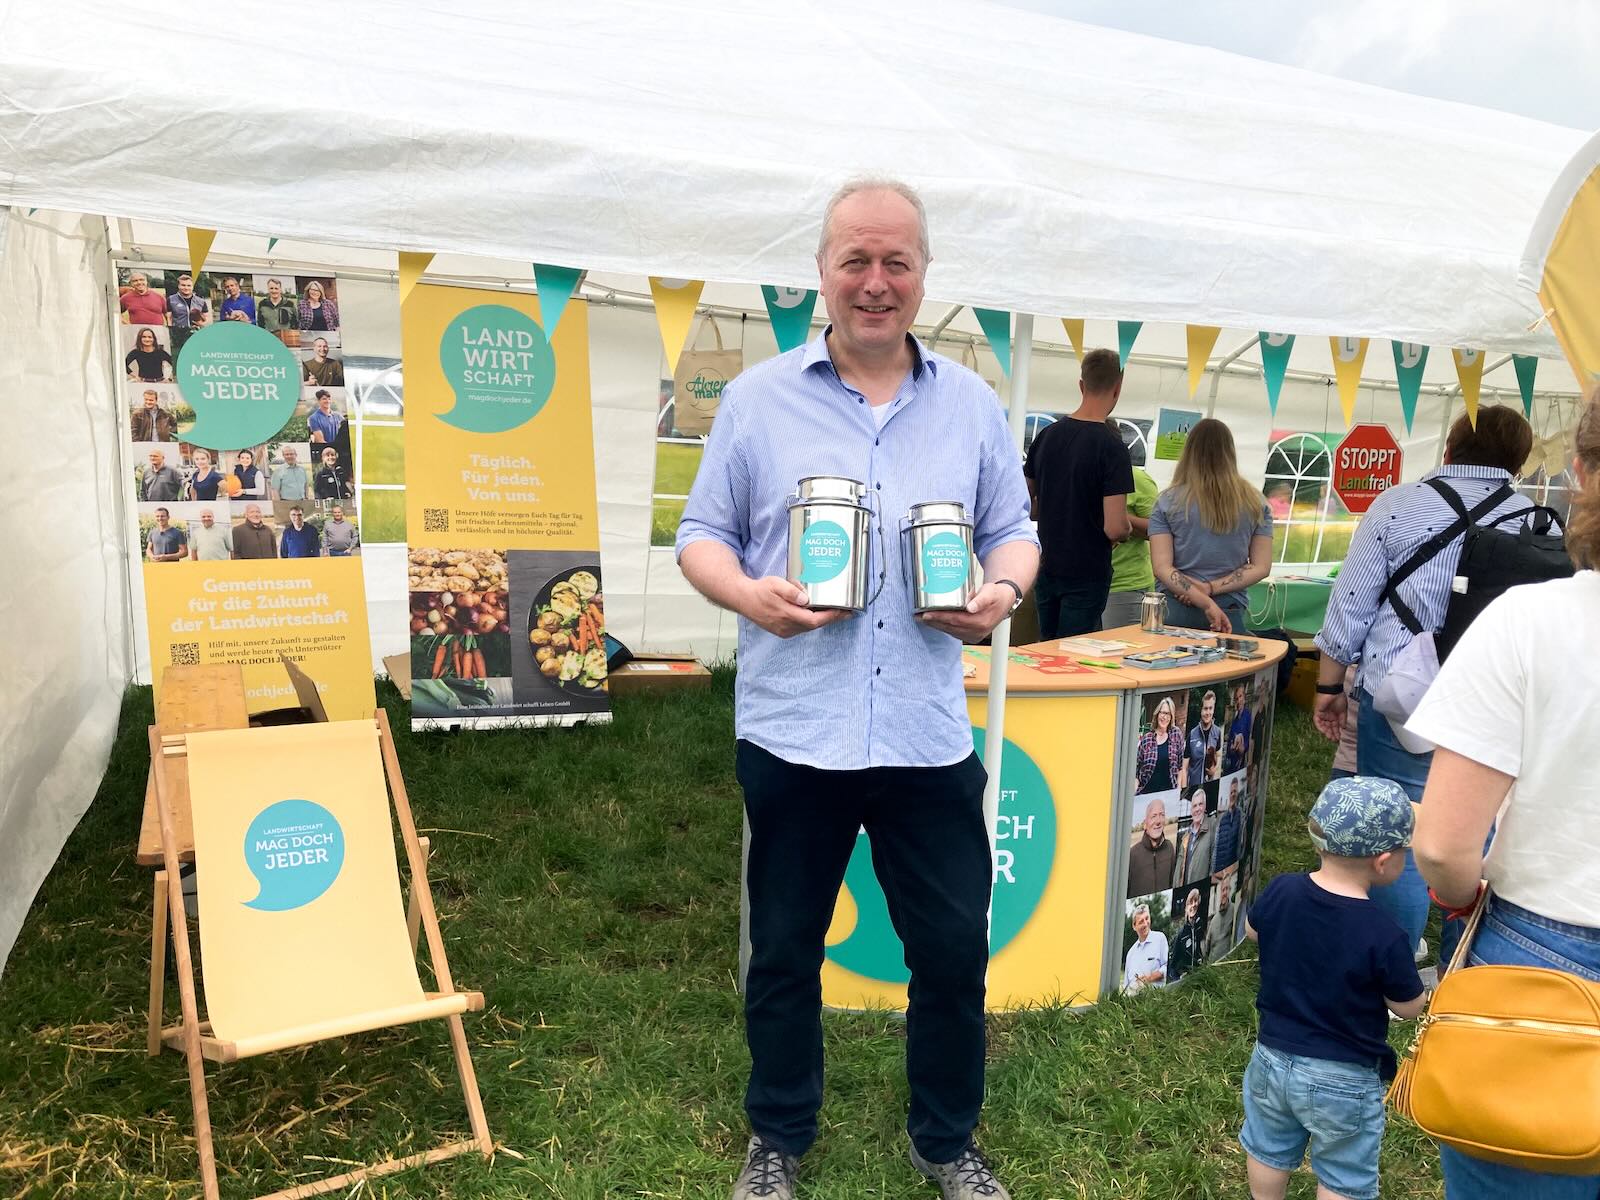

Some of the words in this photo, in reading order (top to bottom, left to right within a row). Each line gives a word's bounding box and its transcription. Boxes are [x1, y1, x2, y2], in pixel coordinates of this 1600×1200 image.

[462, 326, 533, 349] LAND
[200, 352, 274, 360] LANDWIRTSCHAFT
[462, 347, 534, 371] WIRT
[191, 364, 231, 377] MAG
[235, 365, 286, 379] DOCH
[463, 370, 535, 387] SCHAFT
[202, 381, 280, 400] JEDER
[469, 453, 536, 470] Täglich.
[1341, 447, 1397, 470] STOPPT
[461, 470, 490, 484] Für
[493, 472, 545, 487] jeden.
[1340, 473, 1393, 491] Landfraß
[468, 487, 501, 500] Von
[505, 491, 540, 502] uns.
[805, 538, 822, 546] MAG
[823, 538, 846, 546] DOCH
[808, 547, 841, 557] JEDER
[931, 558, 963, 568] JEDER
[203, 578, 312, 593] Gemeinsam
[189, 598, 217, 613] für
[223, 596, 252, 611] die
[257, 593, 329, 609] Zukunft
[171, 617, 203, 633] der
[208, 610, 349, 631] Landwirtschaft
[209, 640, 224, 648] Hilf
[243, 639, 269, 647] unsere
[271, 637, 301, 645] Zukunft
[313, 635, 346, 643] gestalten
[209, 650, 225, 658] und
[227, 649, 251, 657] werde
[275, 646, 294, 654] noch
[295, 644, 342, 653] Unterstützer
[248, 657, 275, 665] DOCH
[263, 823, 323, 835] LANDWIRTSCHAFT
[255, 838, 289, 852] MAG
[291, 832, 334, 848] DOCH
[264, 848, 329, 870] JEDER
